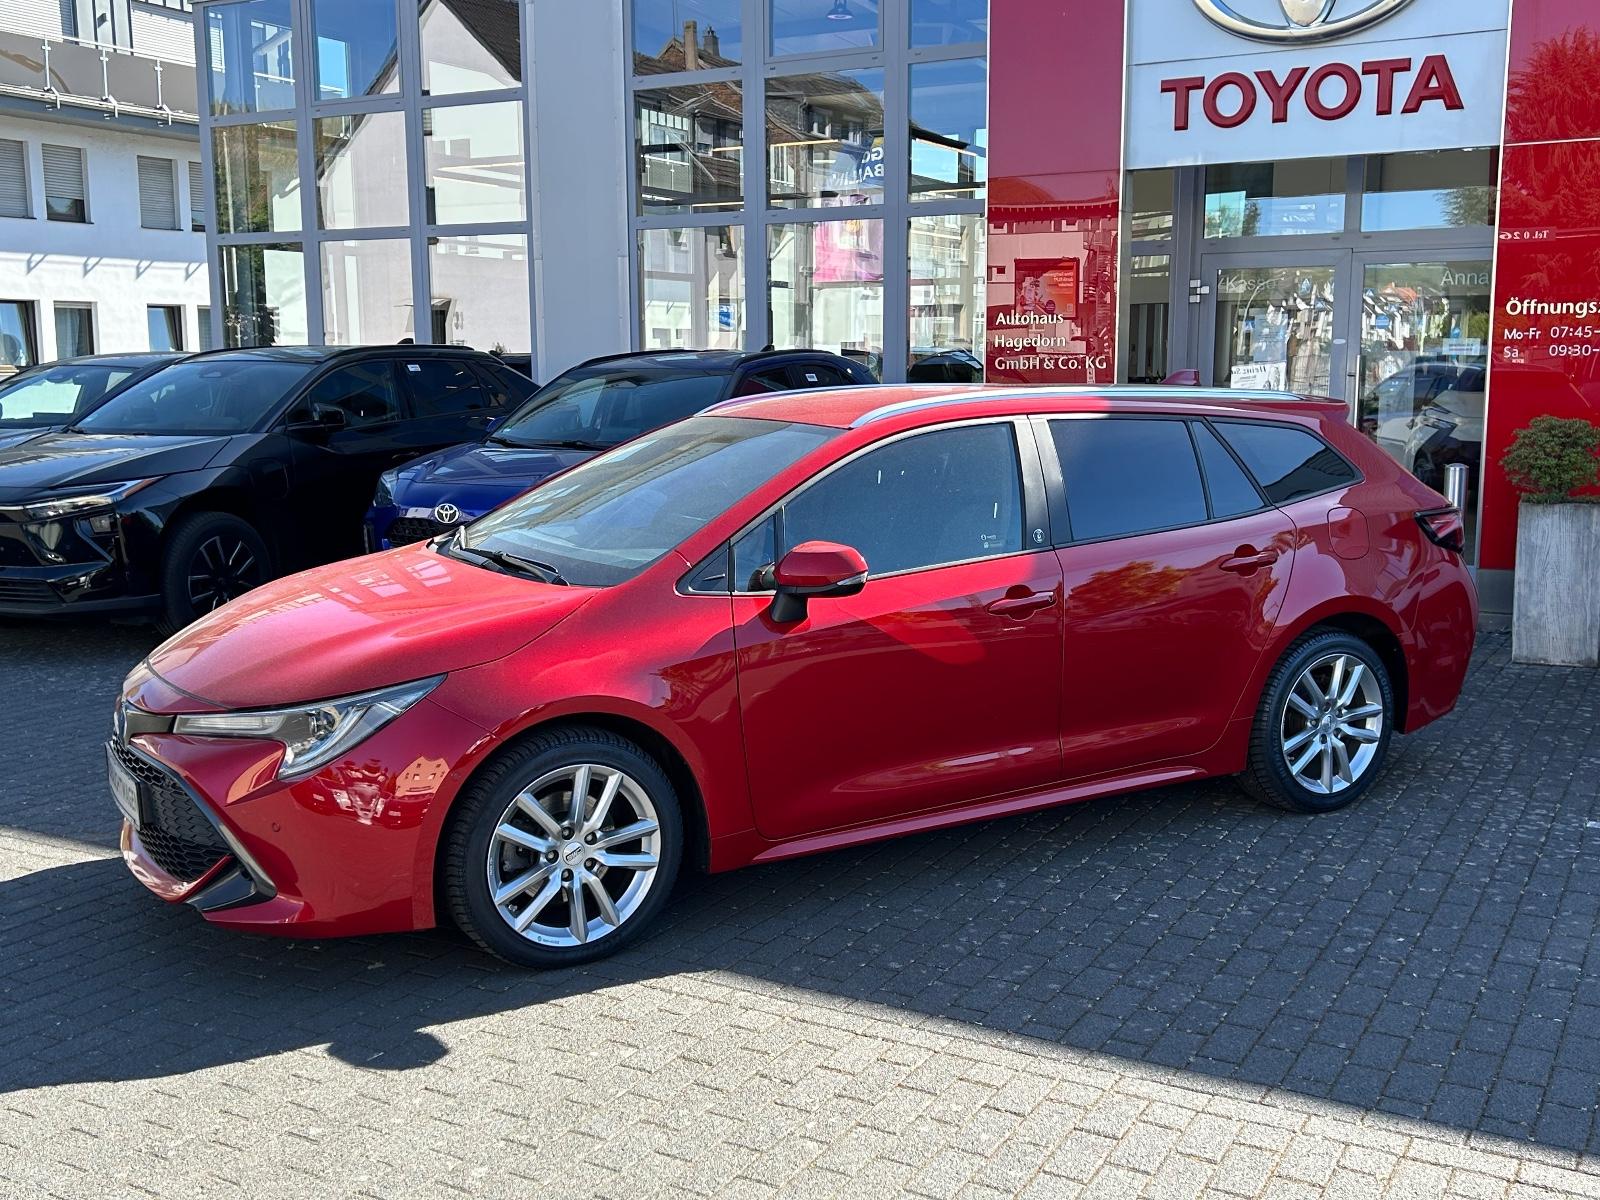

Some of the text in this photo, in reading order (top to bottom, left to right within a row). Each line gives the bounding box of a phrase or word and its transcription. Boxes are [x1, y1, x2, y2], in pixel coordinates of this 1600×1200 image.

[1160, 54, 1464, 131] TOYOTA
[1505, 297, 1600, 318] Öffnungs
[995, 311, 1064, 325] Autohaus
[1503, 328, 1541, 340] Mo-Fr
[994, 334, 1066, 351] Hagedorn
[1503, 346, 1519, 358] Sa
[994, 355, 1107, 370] GmbH & Co. KG
